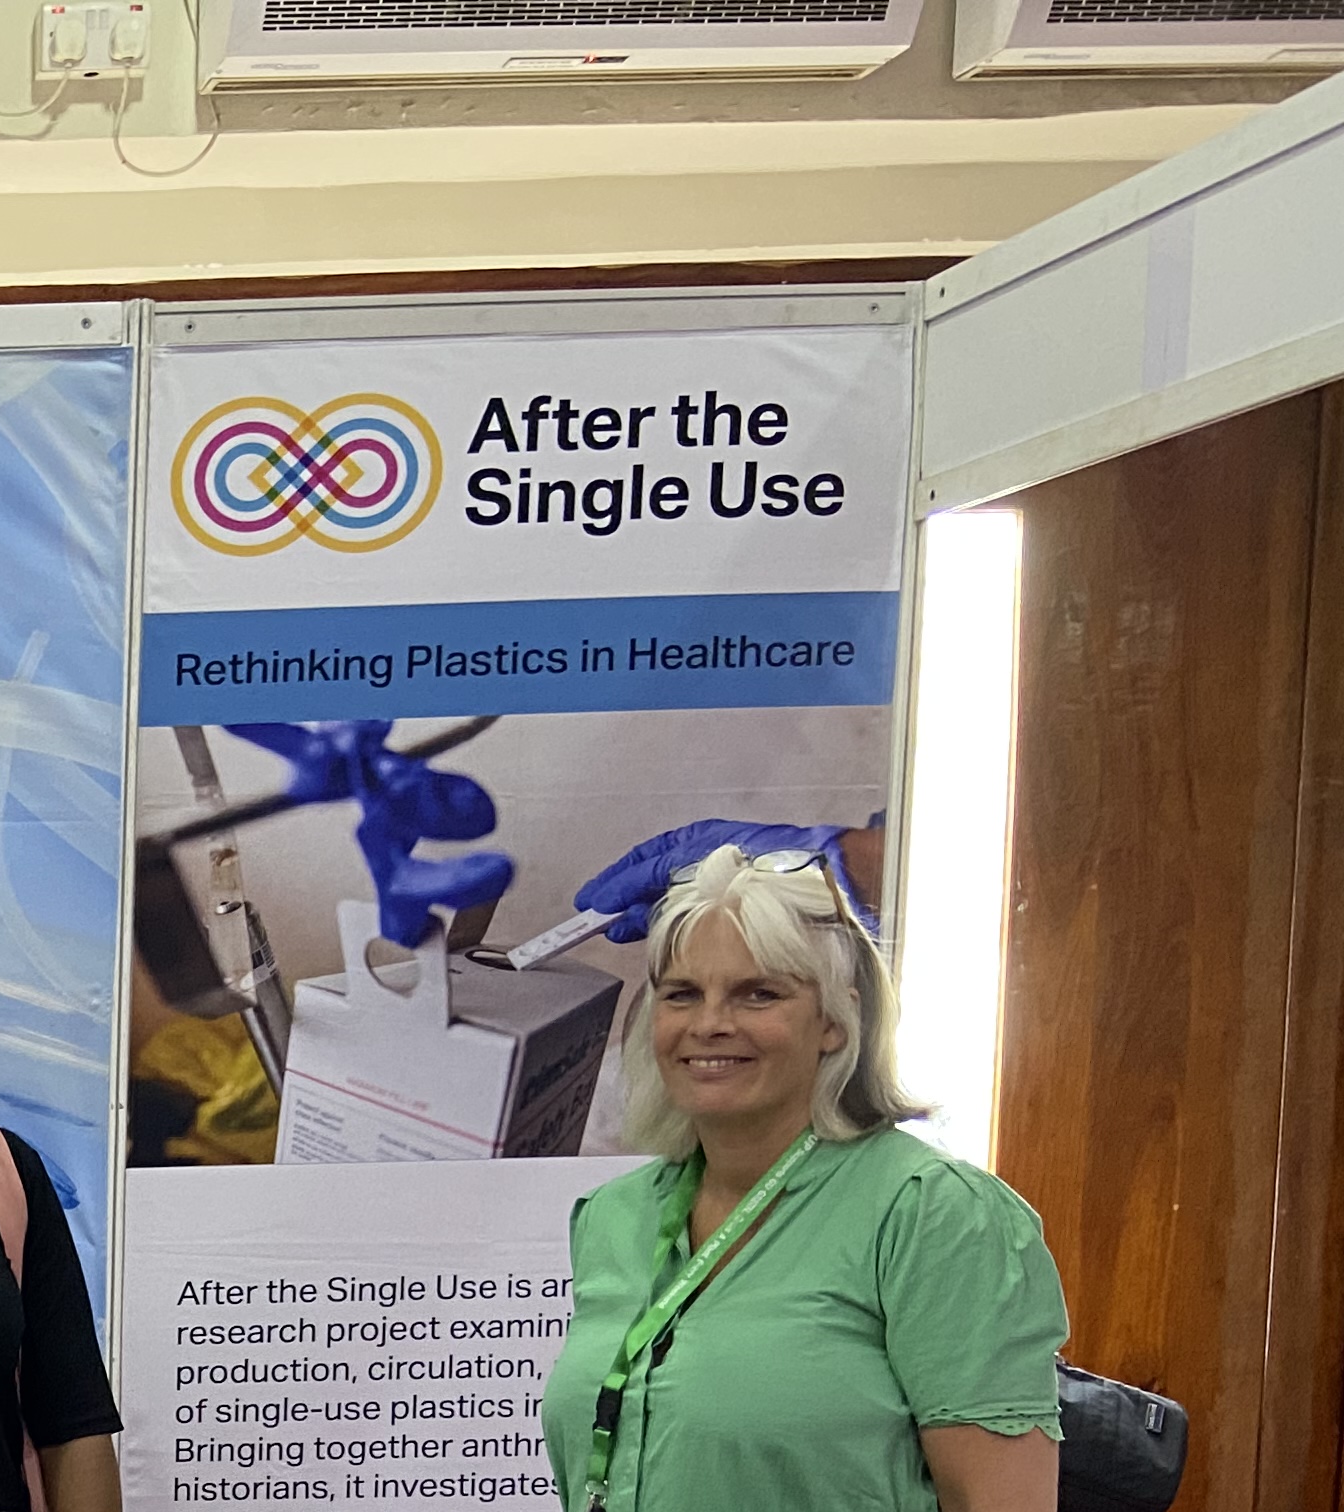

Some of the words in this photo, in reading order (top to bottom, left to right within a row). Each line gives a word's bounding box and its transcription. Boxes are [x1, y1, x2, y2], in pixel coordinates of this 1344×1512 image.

[467, 395, 654, 454] After
[670, 391, 788, 447] the
[464, 462, 689, 536] Single
[709, 462, 844, 518] Use
[176, 648, 393, 688] Rethinking
[408, 640, 568, 678] Plastics
[581, 638, 613, 672] in
[630, 634, 855, 669] Healthcare
[177, 1279, 258, 1306] After
[266, 1279, 317, 1304] the
[327, 1276, 426, 1307] Single
[436, 1274, 497, 1300] Use
[508, 1274, 532, 1298] is
[177, 1318, 316, 1345] research
[326, 1315, 441, 1348] project
[176, 1359, 358, 1390] production,
[368, 1354, 543, 1381] circulation,
[175, 1398, 208, 1424] of
[216, 1398, 381, 1428] single-use
[392, 1394, 514, 1425] plastics
[175, 1437, 304, 1468] Bringing
[314, 1434, 454, 1466] together
[174, 1476, 335, 1502] historians,
[345, 1474, 365, 1498] it
